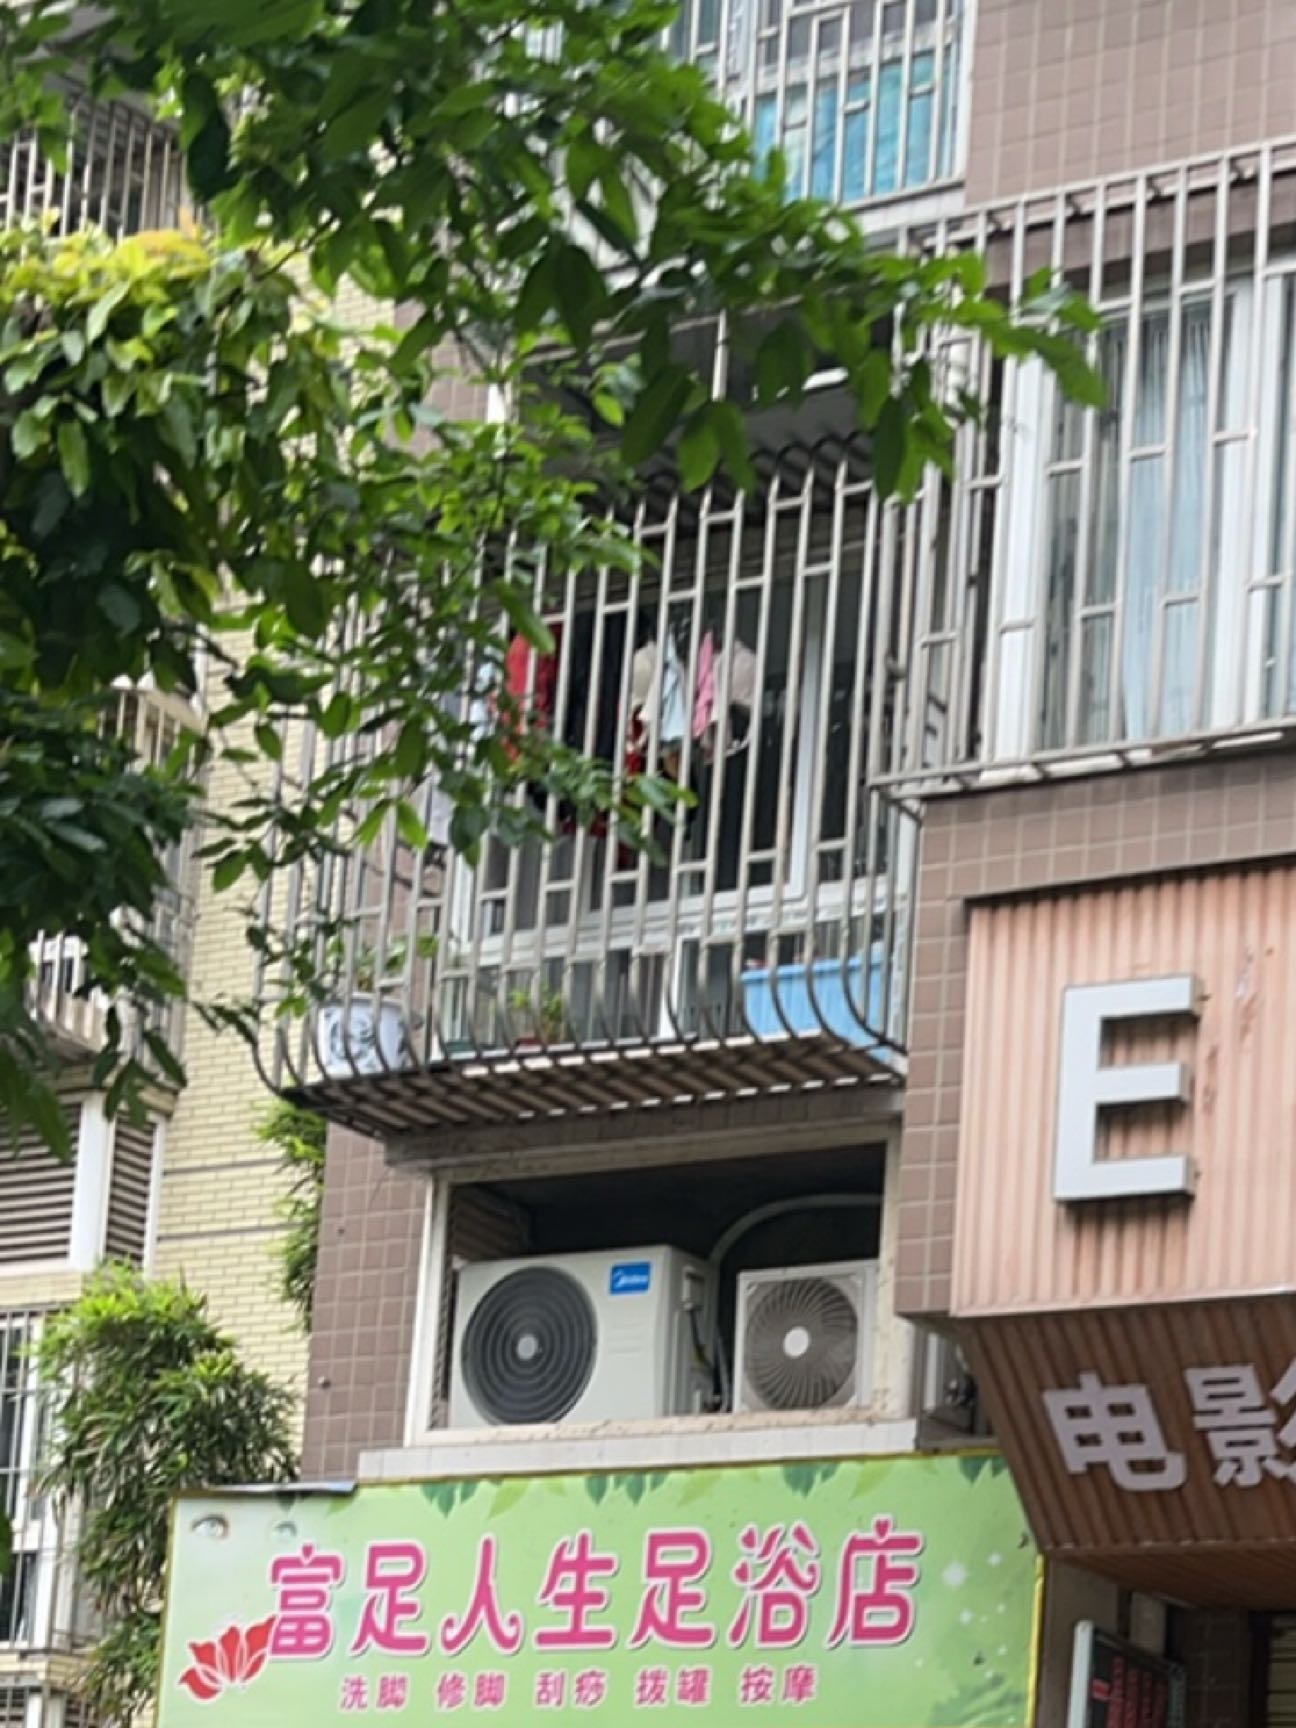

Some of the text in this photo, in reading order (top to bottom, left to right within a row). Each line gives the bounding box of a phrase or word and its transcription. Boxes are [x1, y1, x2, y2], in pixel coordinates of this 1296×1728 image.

[266, 1517, 923, 1660] 富足人生足浴店
[340, 1674, 407, 1709] 洗脚
[437, 1673, 505, 1708] 修脚
[740, 1664, 815, 1702] 按摩
